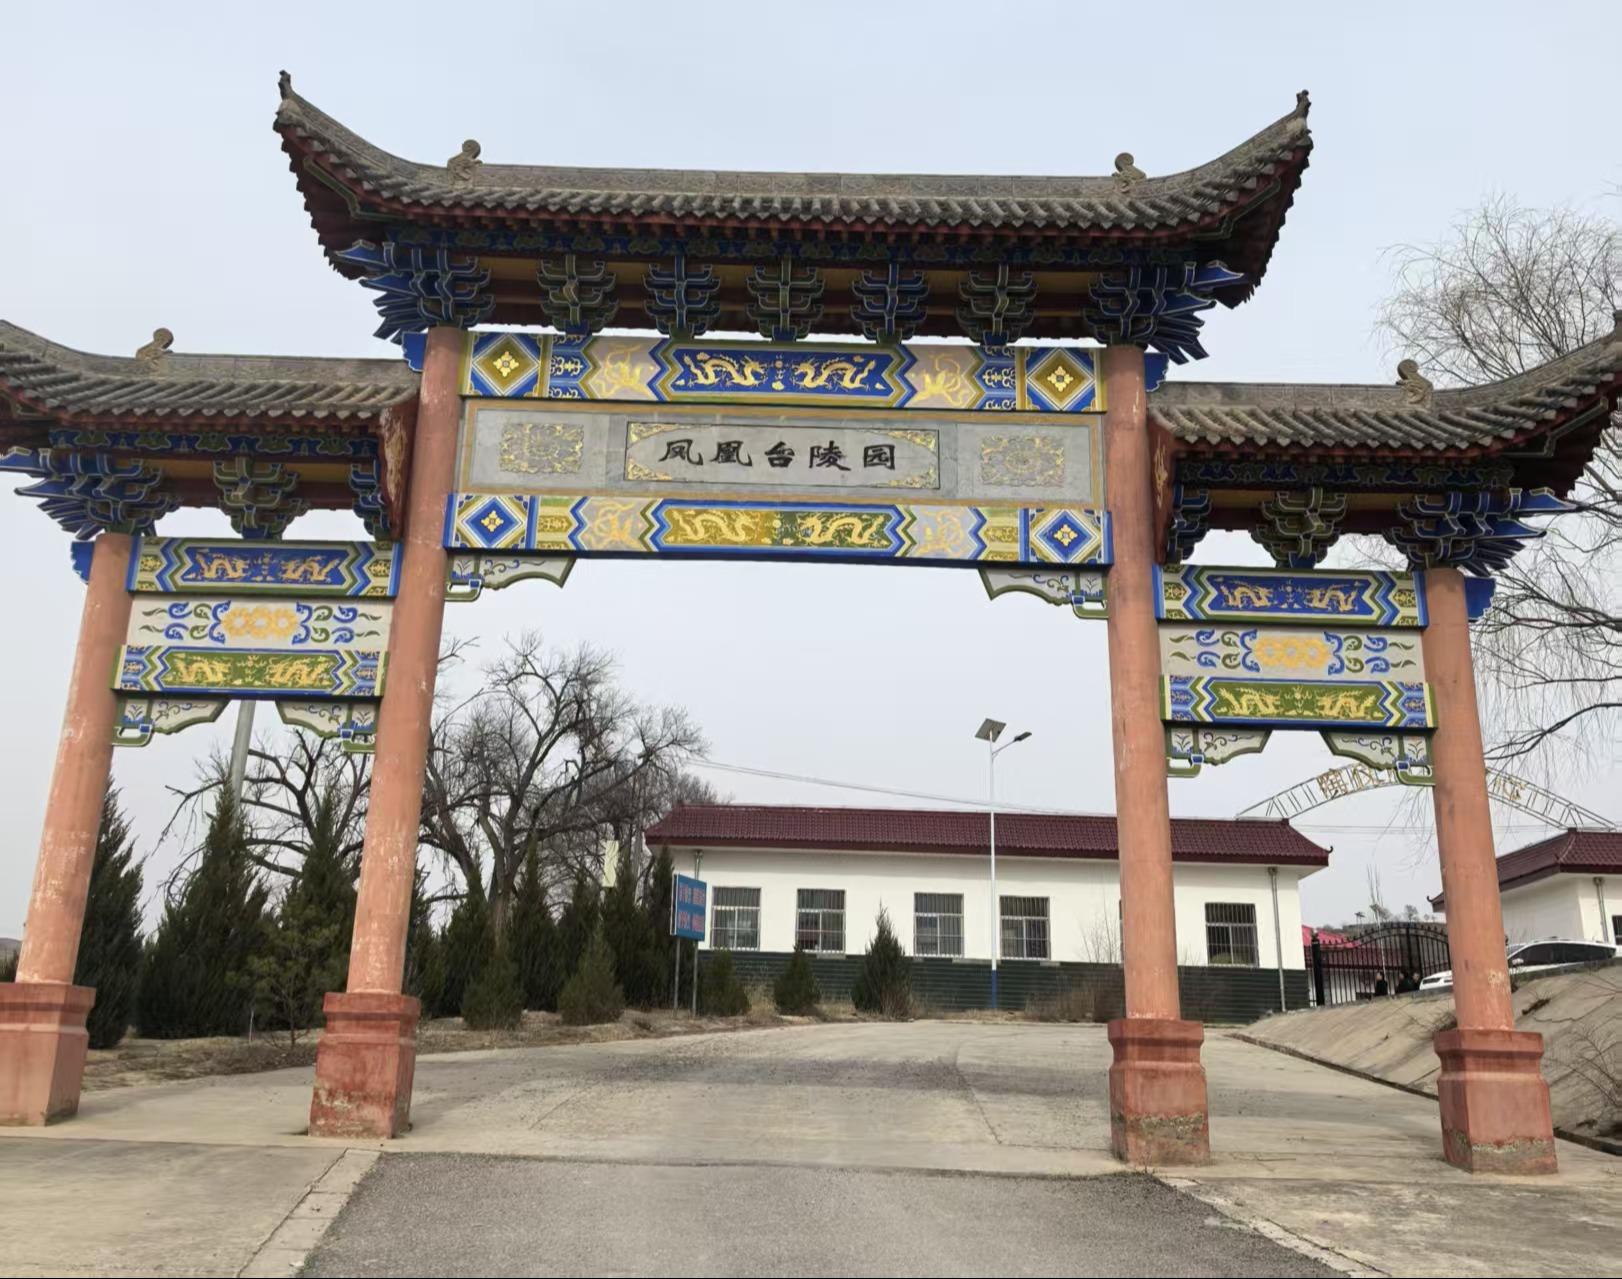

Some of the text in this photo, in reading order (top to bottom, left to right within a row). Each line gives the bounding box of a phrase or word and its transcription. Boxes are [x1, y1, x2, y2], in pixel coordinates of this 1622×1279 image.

[659, 440, 896, 471] 凤凰台陵园
